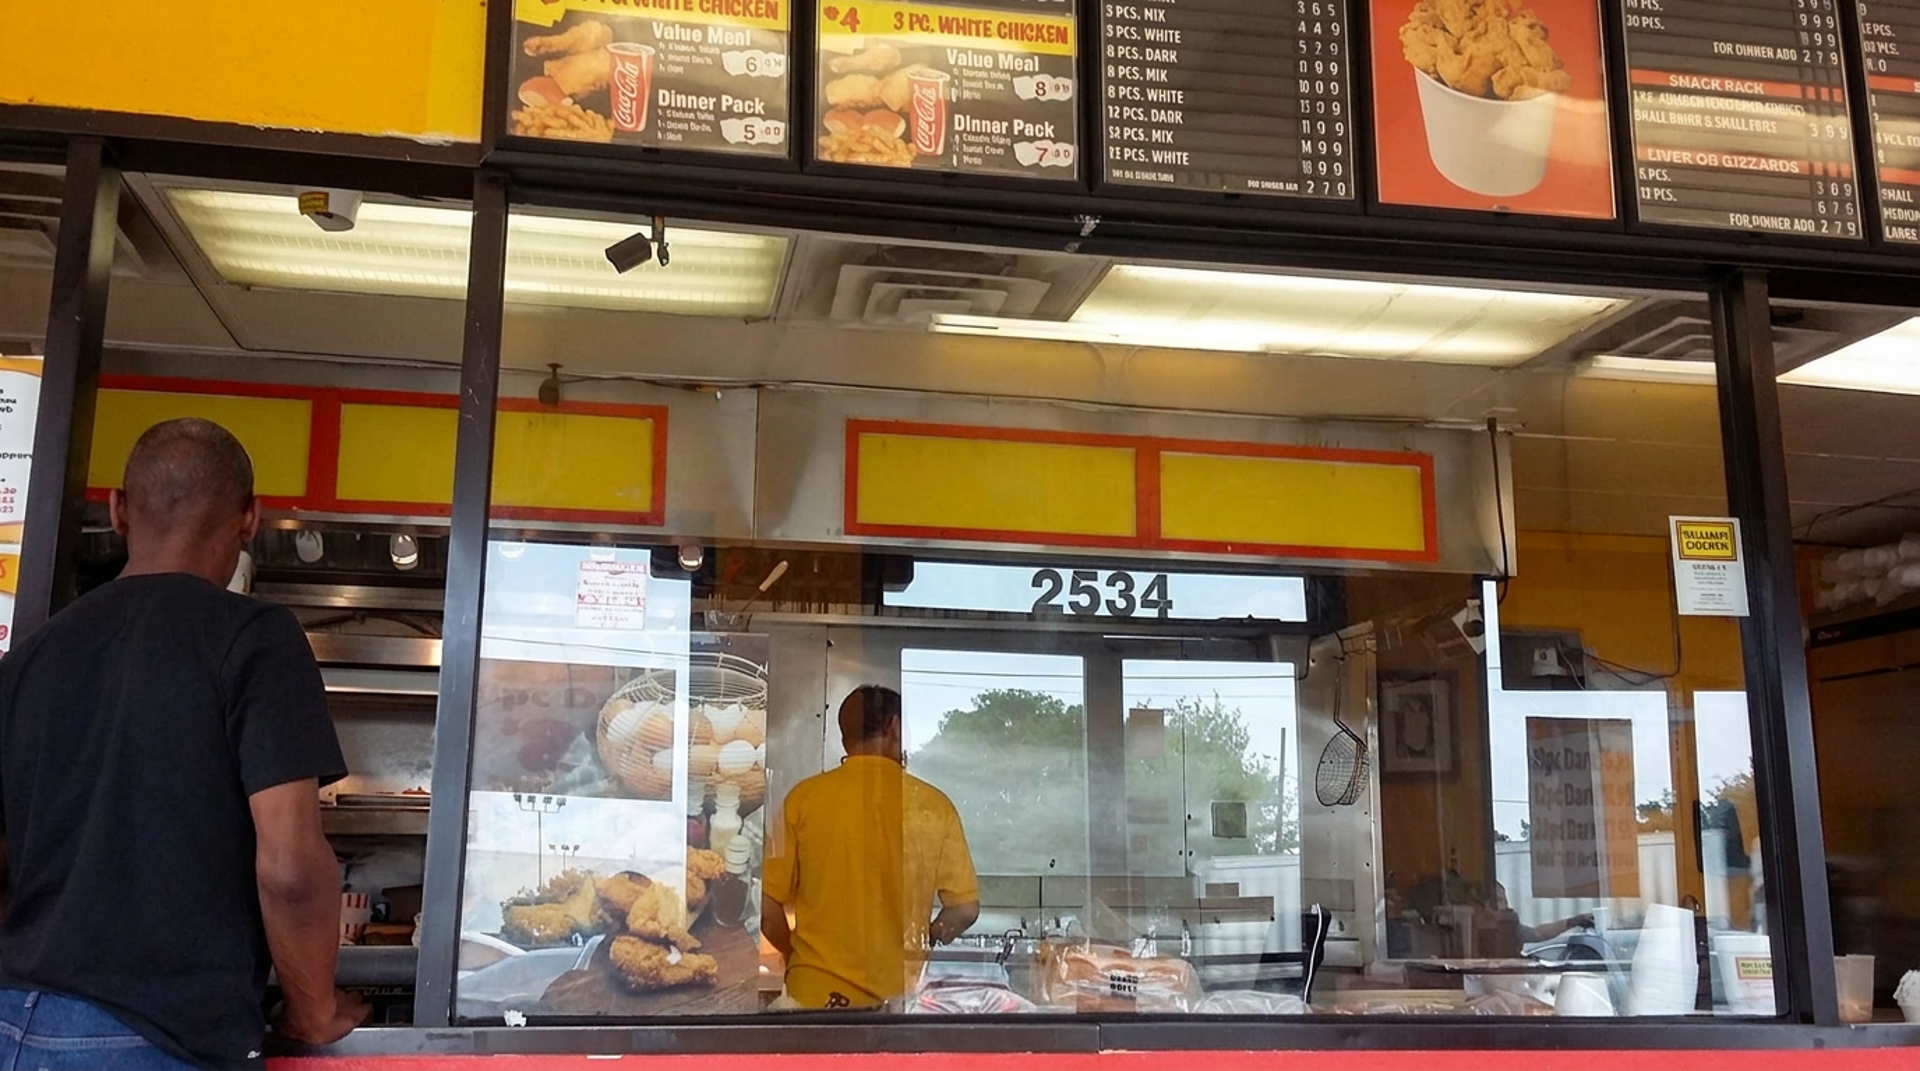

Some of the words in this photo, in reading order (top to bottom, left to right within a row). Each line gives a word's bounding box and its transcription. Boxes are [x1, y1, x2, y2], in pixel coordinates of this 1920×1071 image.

[698, 0, 779, 20] CHICKEN
[652, 22, 703, 43] Value
[893, 12, 904, 29] 3
[938, 15, 993, 39] WHITE
[996, 19, 1068, 45] CHICKEN
[1144, 27, 1181, 43] WHITE
[946, 48, 993, 69] Value
[999, 53, 1040, 72] Meal
[1146, 48, 1178, 63] DARK
[745, 56, 758, 73] 6
[1034, 81, 1047, 96] 8
[1108, 85, 1116, 98] 8
[1118, 85, 1144, 101] PCS.
[1146, 88, 1184, 104] WHITE
[1725, 80, 1765, 95] RACK
[658, 89, 717, 111] Dinner
[721, 94, 766, 115] Pack
[1108, 105, 1120, 119] 12
[1122, 107, 1148, 121] PCS.
[744, 124, 756, 140] 5
[1013, 118, 1055, 138] Pack
[1123, 127, 1149, 142] PCS.
[1151, 129, 1174, 144] MIX
[1035, 147, 1048, 163] 7
[1123, 147, 1149, 162] PCS.
[1151, 150, 1189, 165] WHITE
[1031, 568, 1174, 619] 2534
